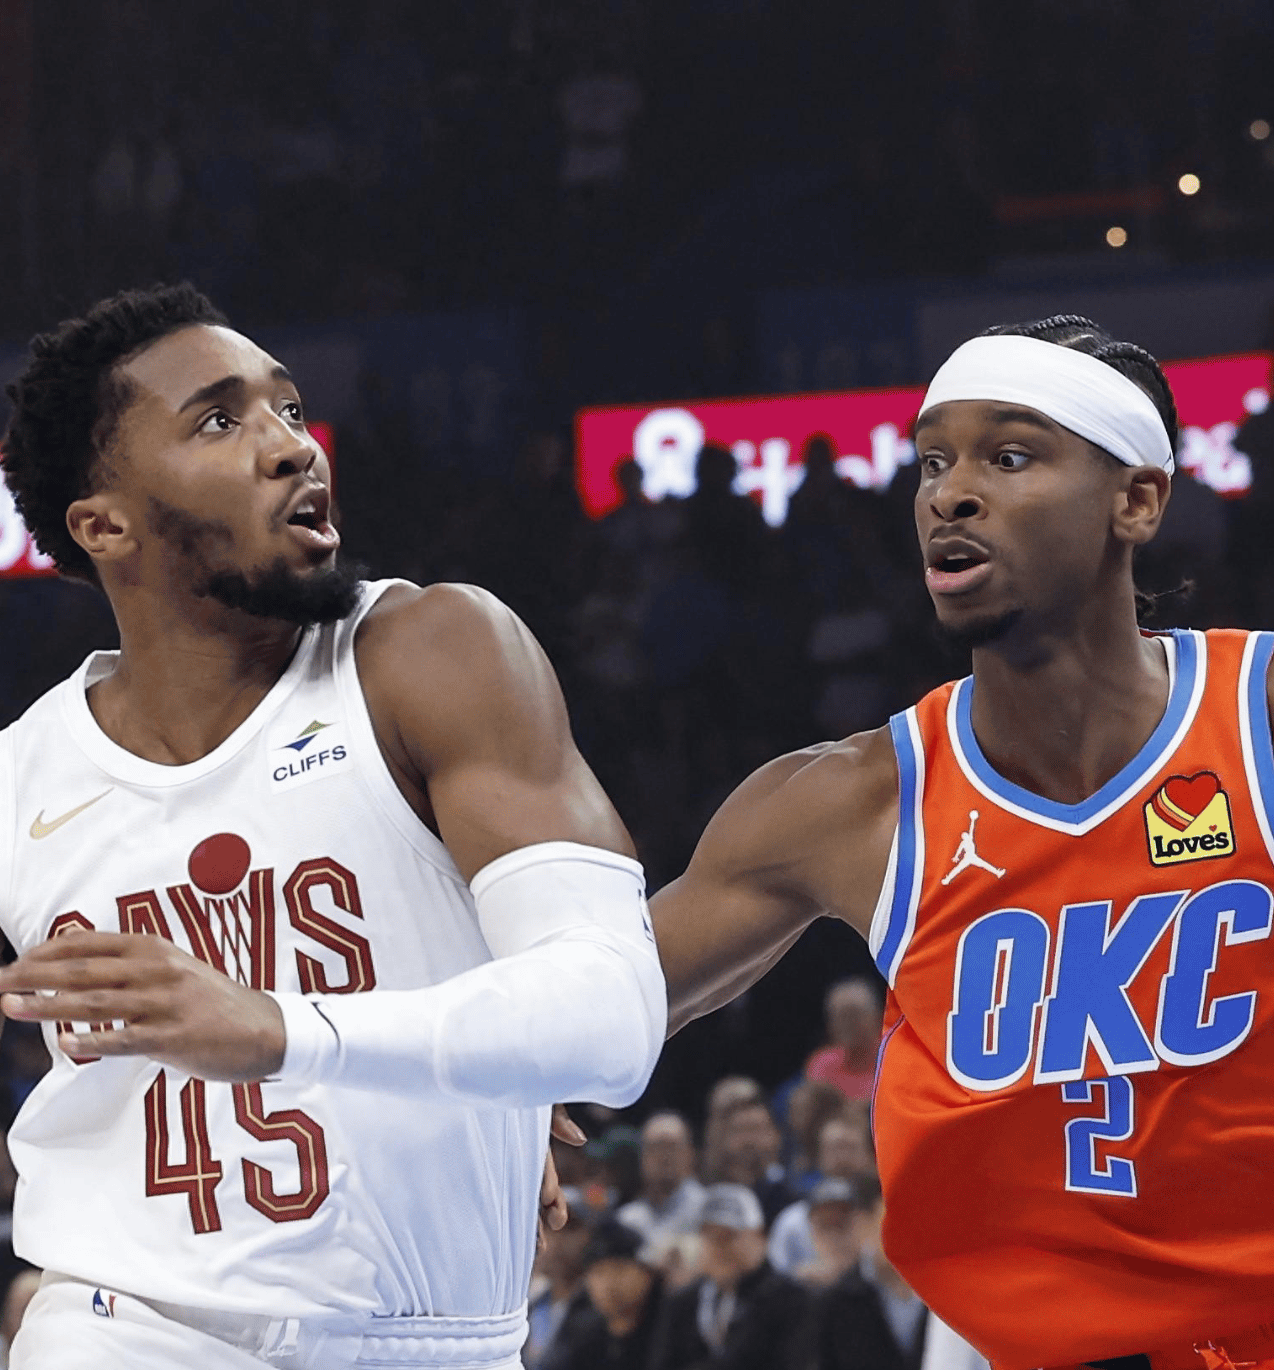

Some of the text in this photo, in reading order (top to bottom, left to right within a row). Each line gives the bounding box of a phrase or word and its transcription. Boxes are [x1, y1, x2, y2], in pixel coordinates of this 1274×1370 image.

[272, 743, 348, 783] CLIFFS
[1153, 829, 1230, 860] Loves
[945, 878, 1274, 1092] OKC
[144, 1067, 331, 1235] 45
[1061, 1074, 1138, 1198] 2
